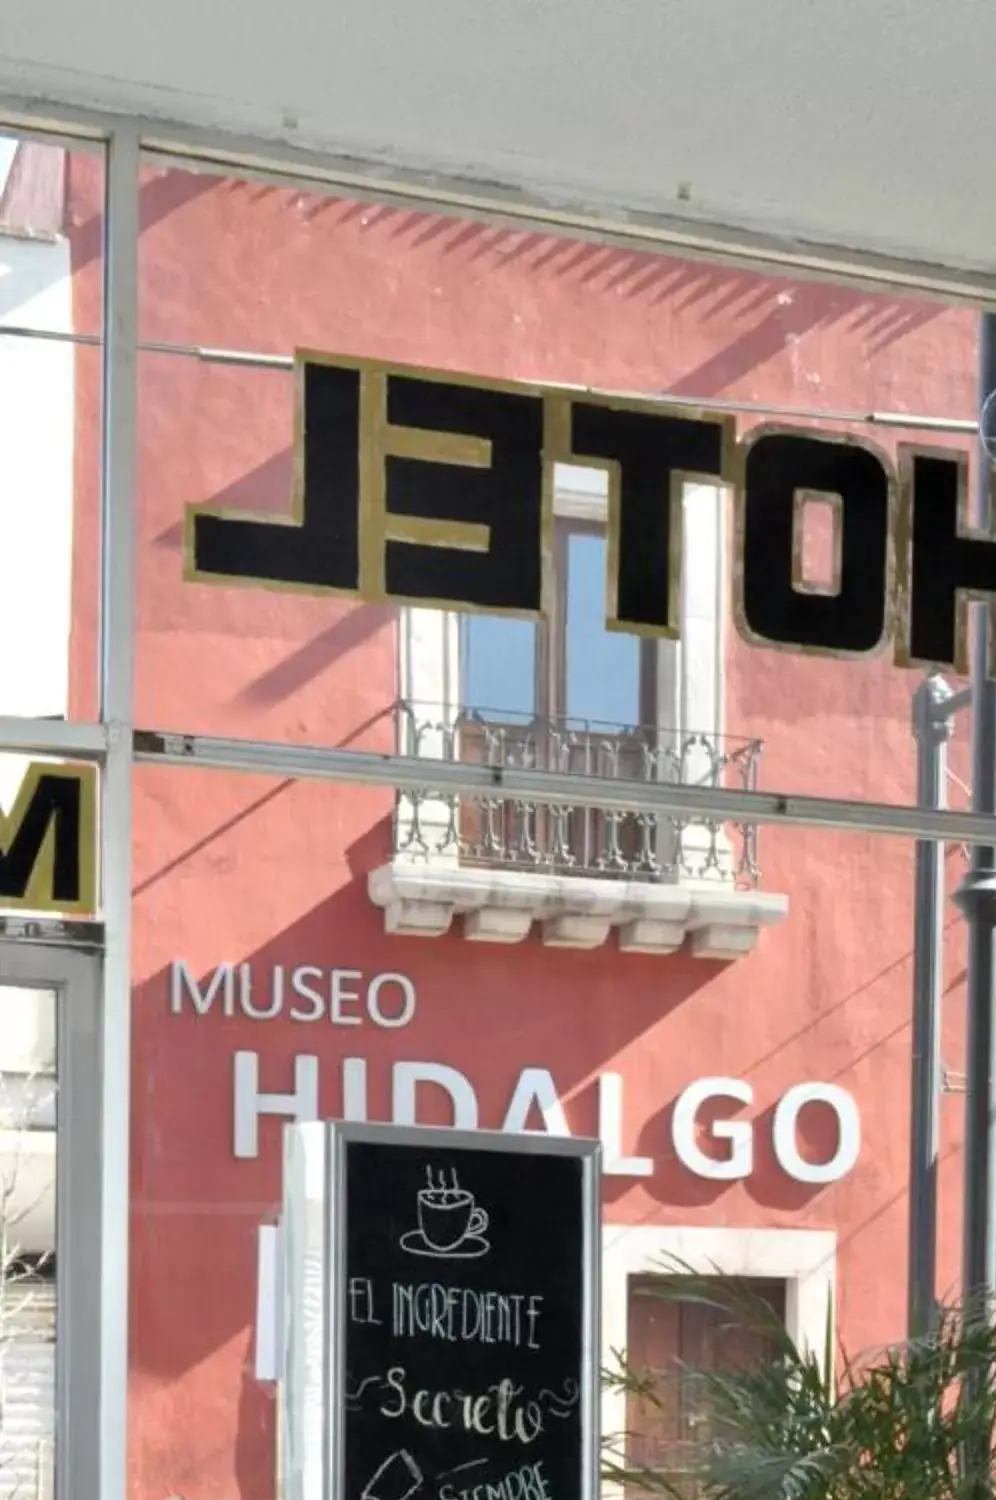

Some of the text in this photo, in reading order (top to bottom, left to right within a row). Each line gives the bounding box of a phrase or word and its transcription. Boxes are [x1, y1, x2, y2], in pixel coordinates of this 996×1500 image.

[171, 959, 416, 1028] MUSEO
[233, 1050, 861, 1183] HIDALGO
[348, 1277, 544, 1349] EL INGREDIENTE
[379, 1366, 544, 1444] Secreto
